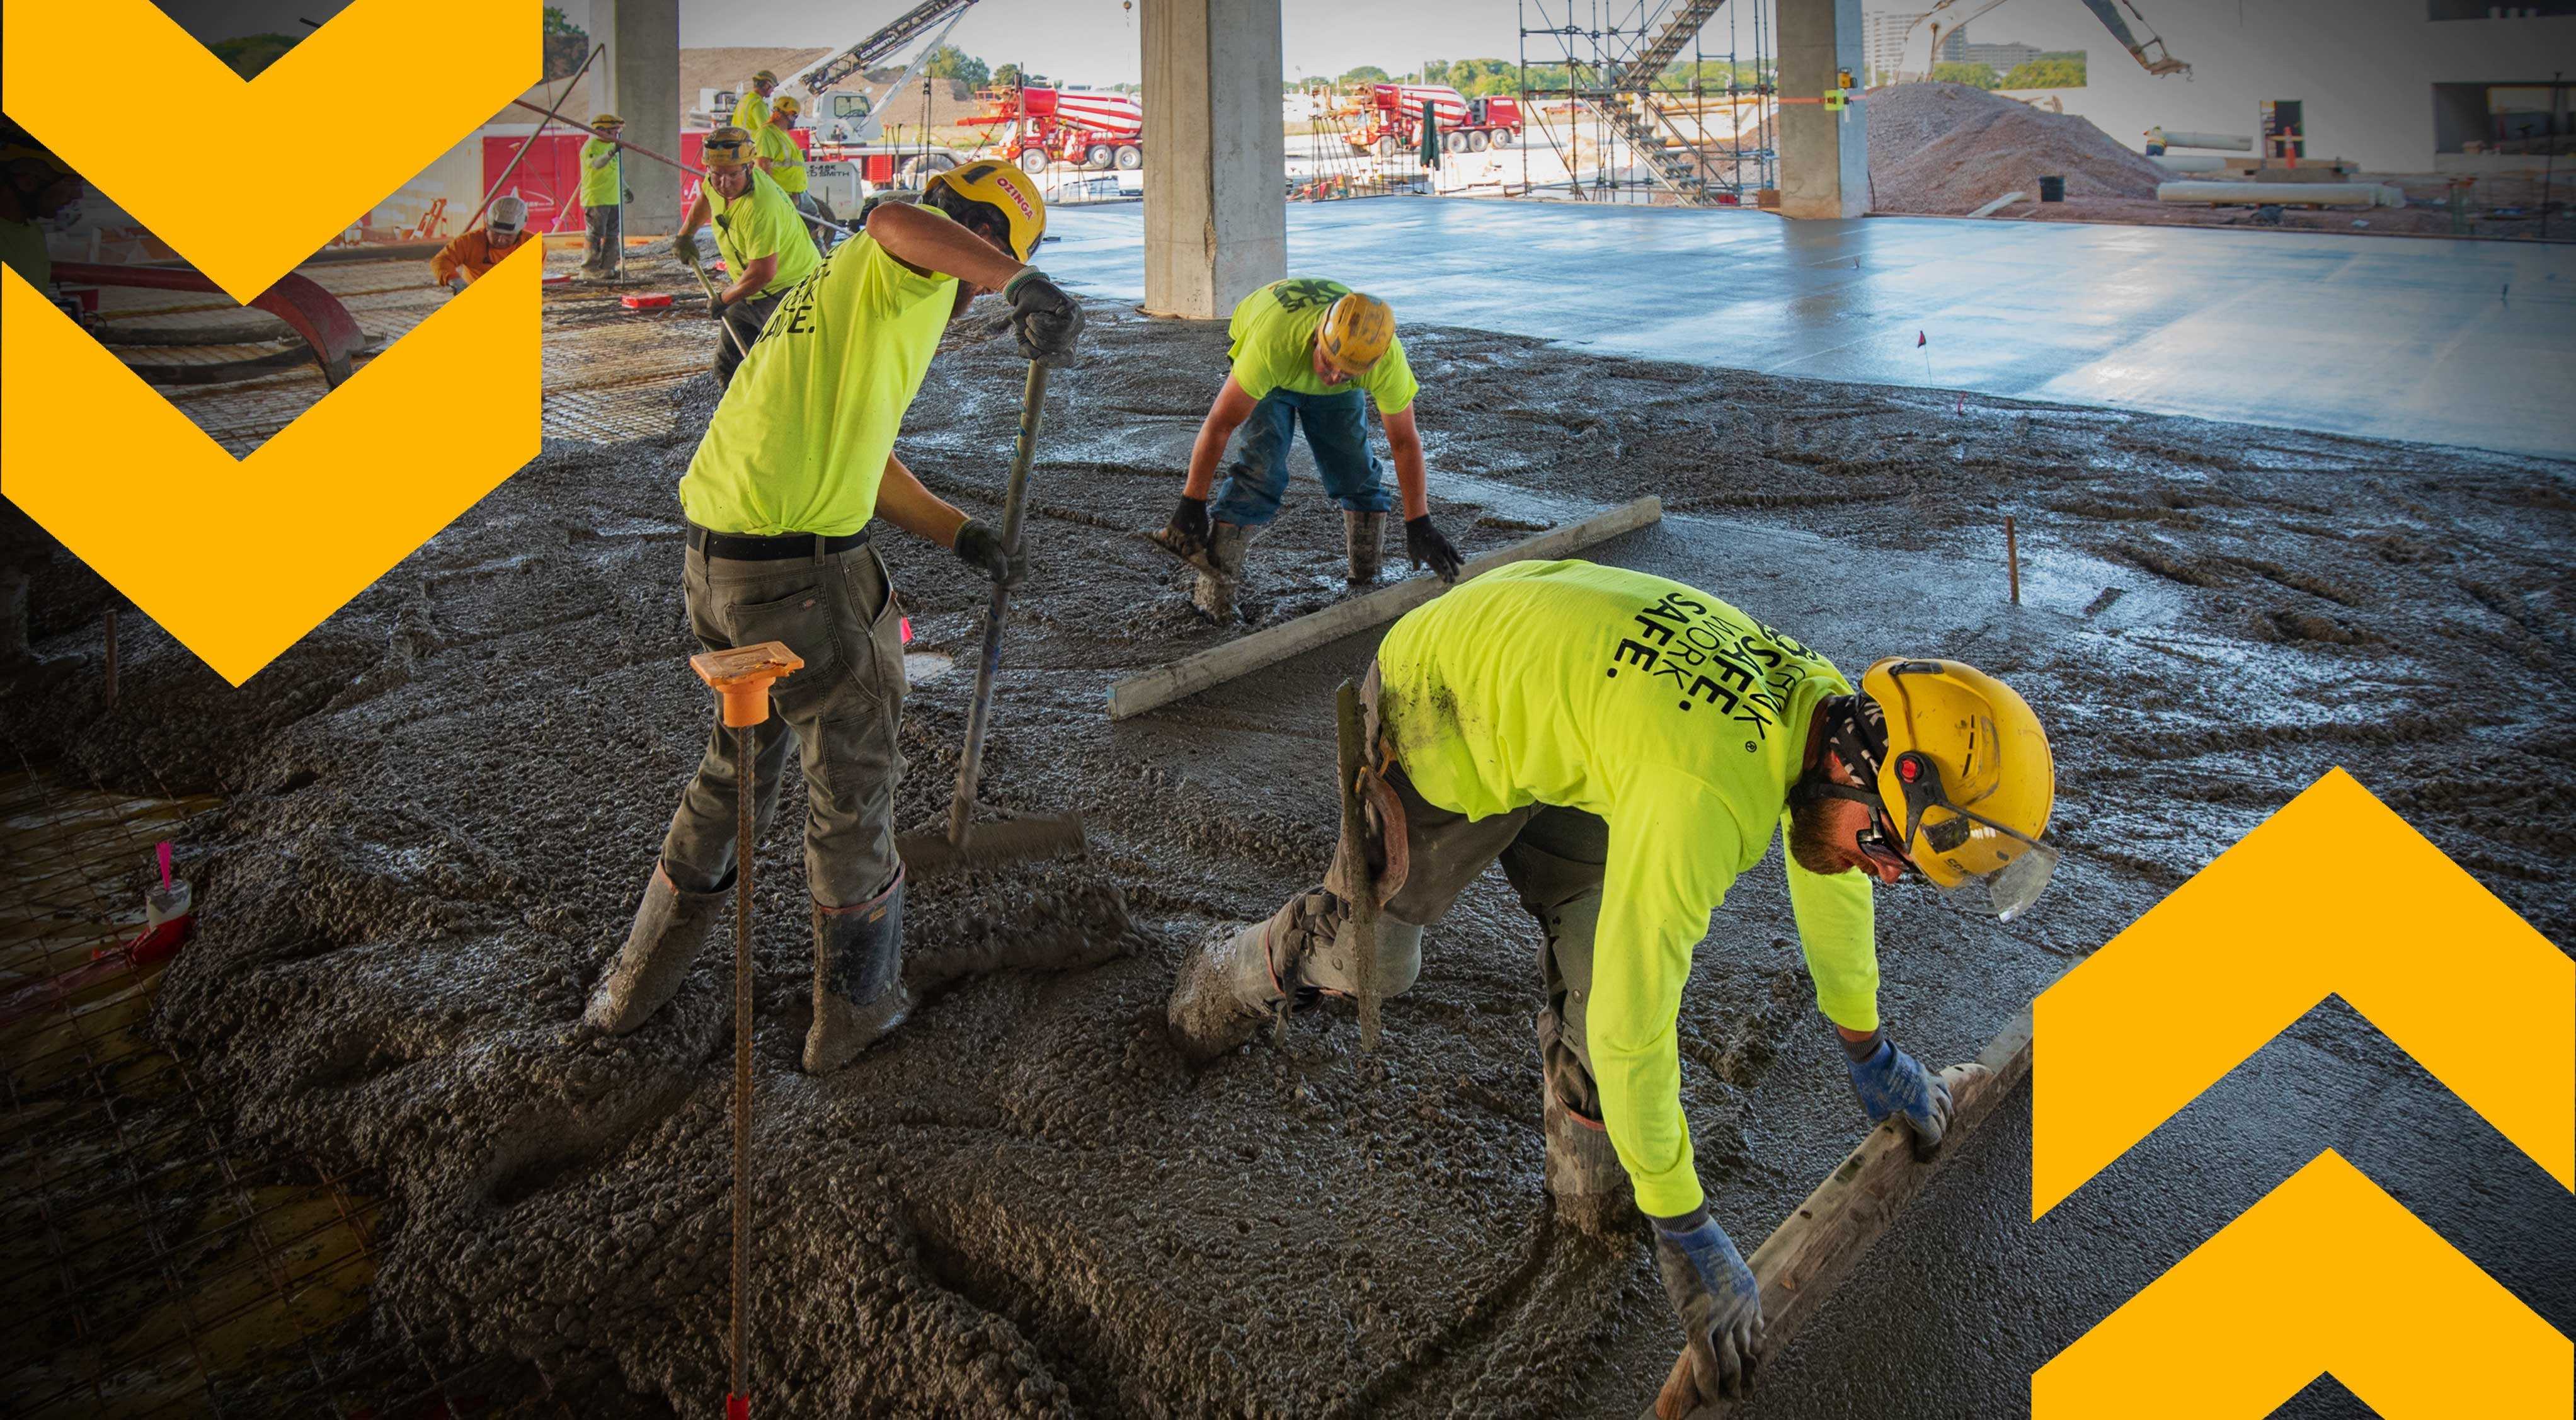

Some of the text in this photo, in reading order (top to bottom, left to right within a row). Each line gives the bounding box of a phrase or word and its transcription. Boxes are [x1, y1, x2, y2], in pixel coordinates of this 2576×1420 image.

[872, 35, 896, 52] SMITH
[997, 177, 1033, 220] OZINGA
[1607, 592, 1707, 679] SAFE.
[1652, 616, 1743, 690] WORK
[1679, 636, 1782, 714] SAFE.
